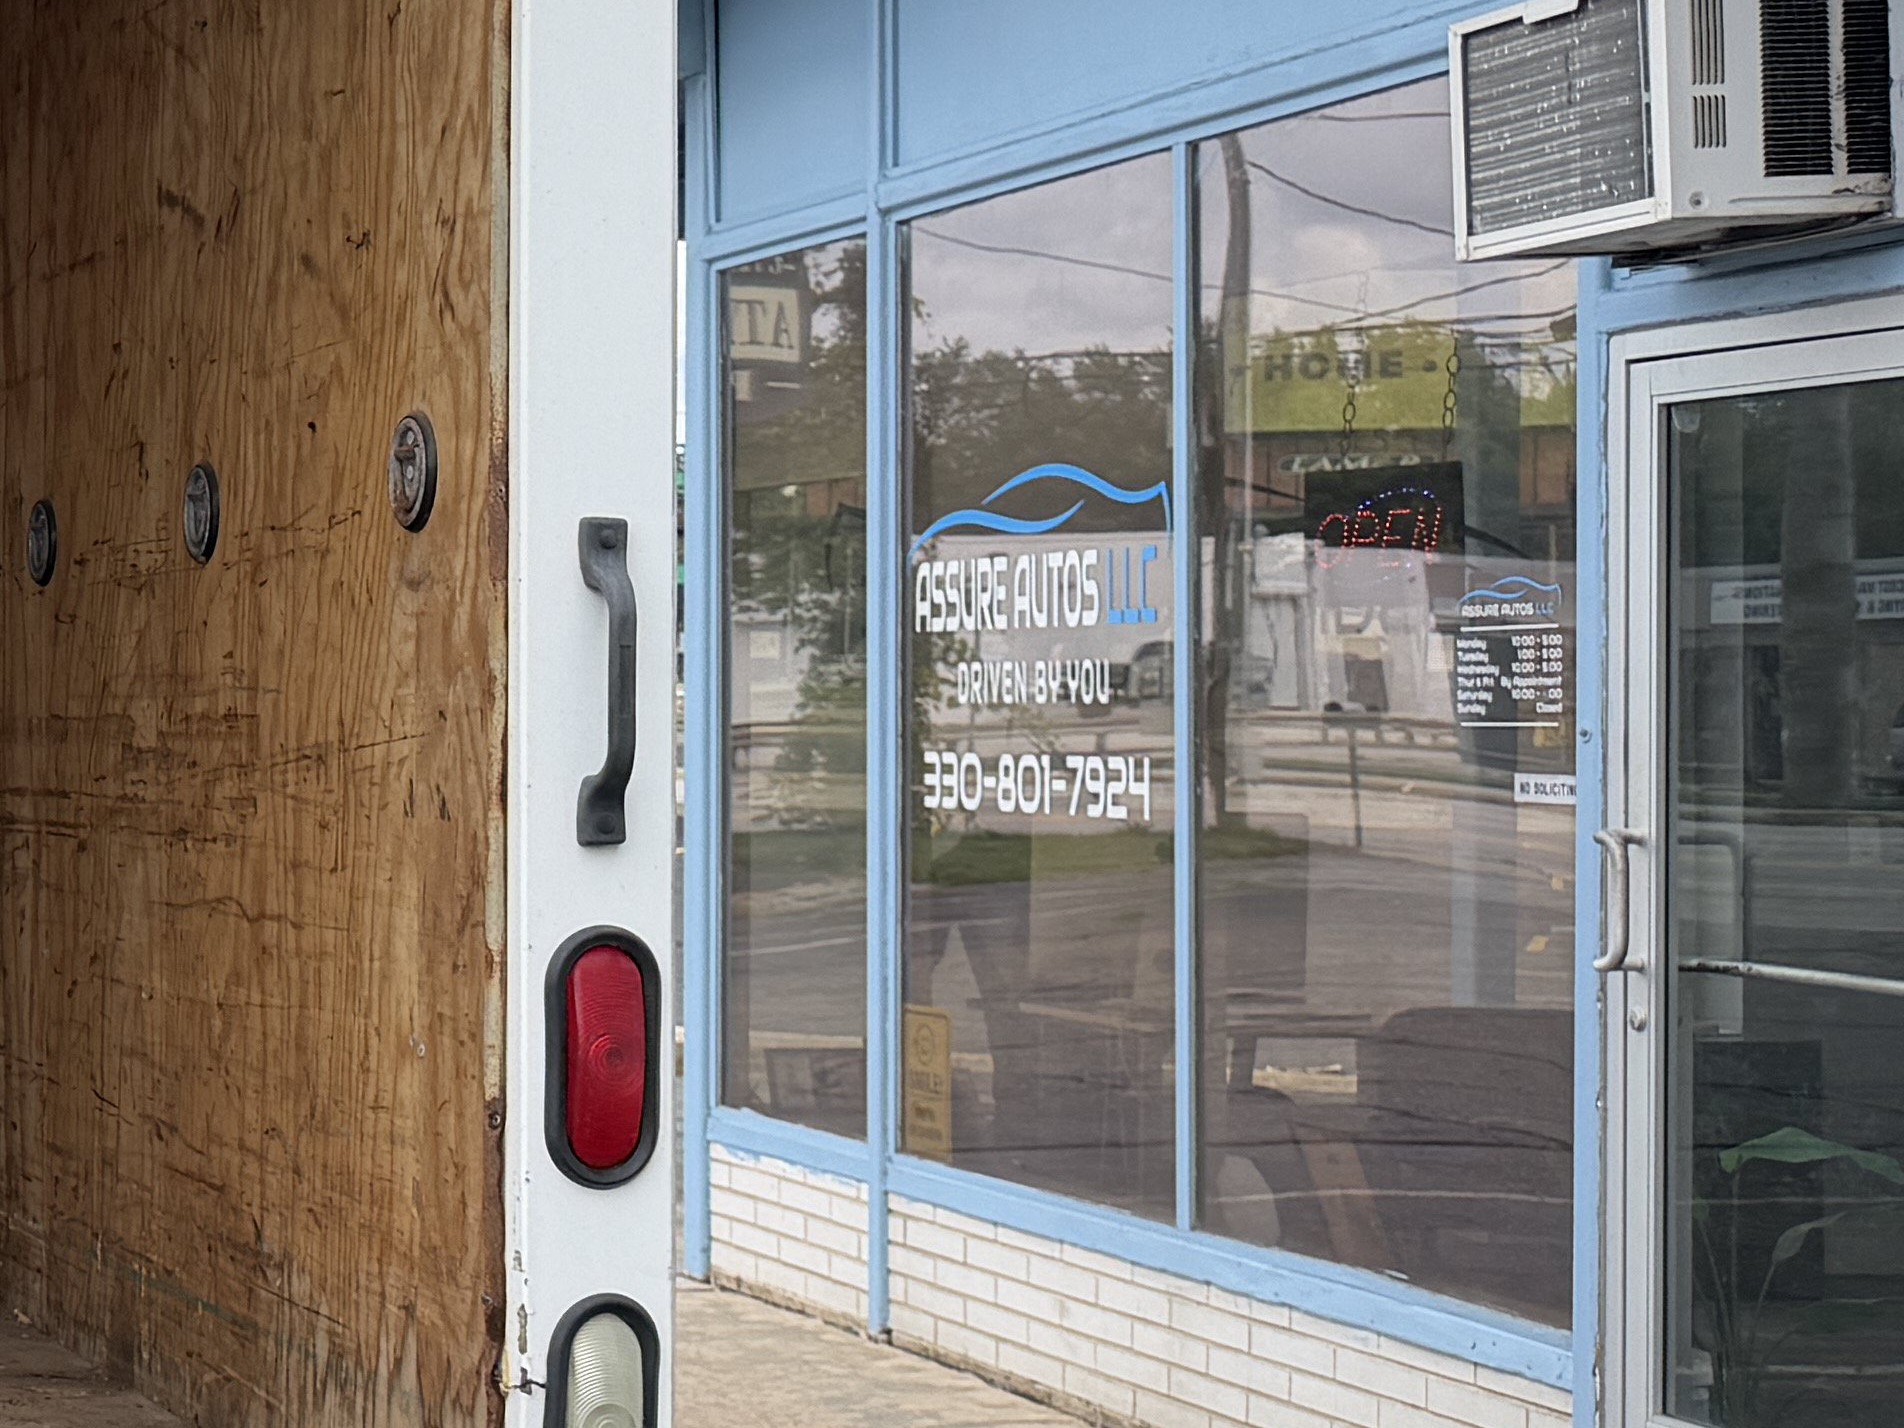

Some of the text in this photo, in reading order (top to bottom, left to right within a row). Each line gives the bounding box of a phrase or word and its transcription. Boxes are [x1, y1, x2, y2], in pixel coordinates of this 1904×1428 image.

[1314, 506, 1443, 570] OPEN
[915, 544, 1158, 633] ASSURE AUTOS LLC
[1500, 602, 1535, 617] AUTOS
[958, 659, 1109, 705] DRIVEN BY YOU
[923, 751, 1151, 821] 330-801-7924
[1534, 781, 1577, 797] SOLICITIN
